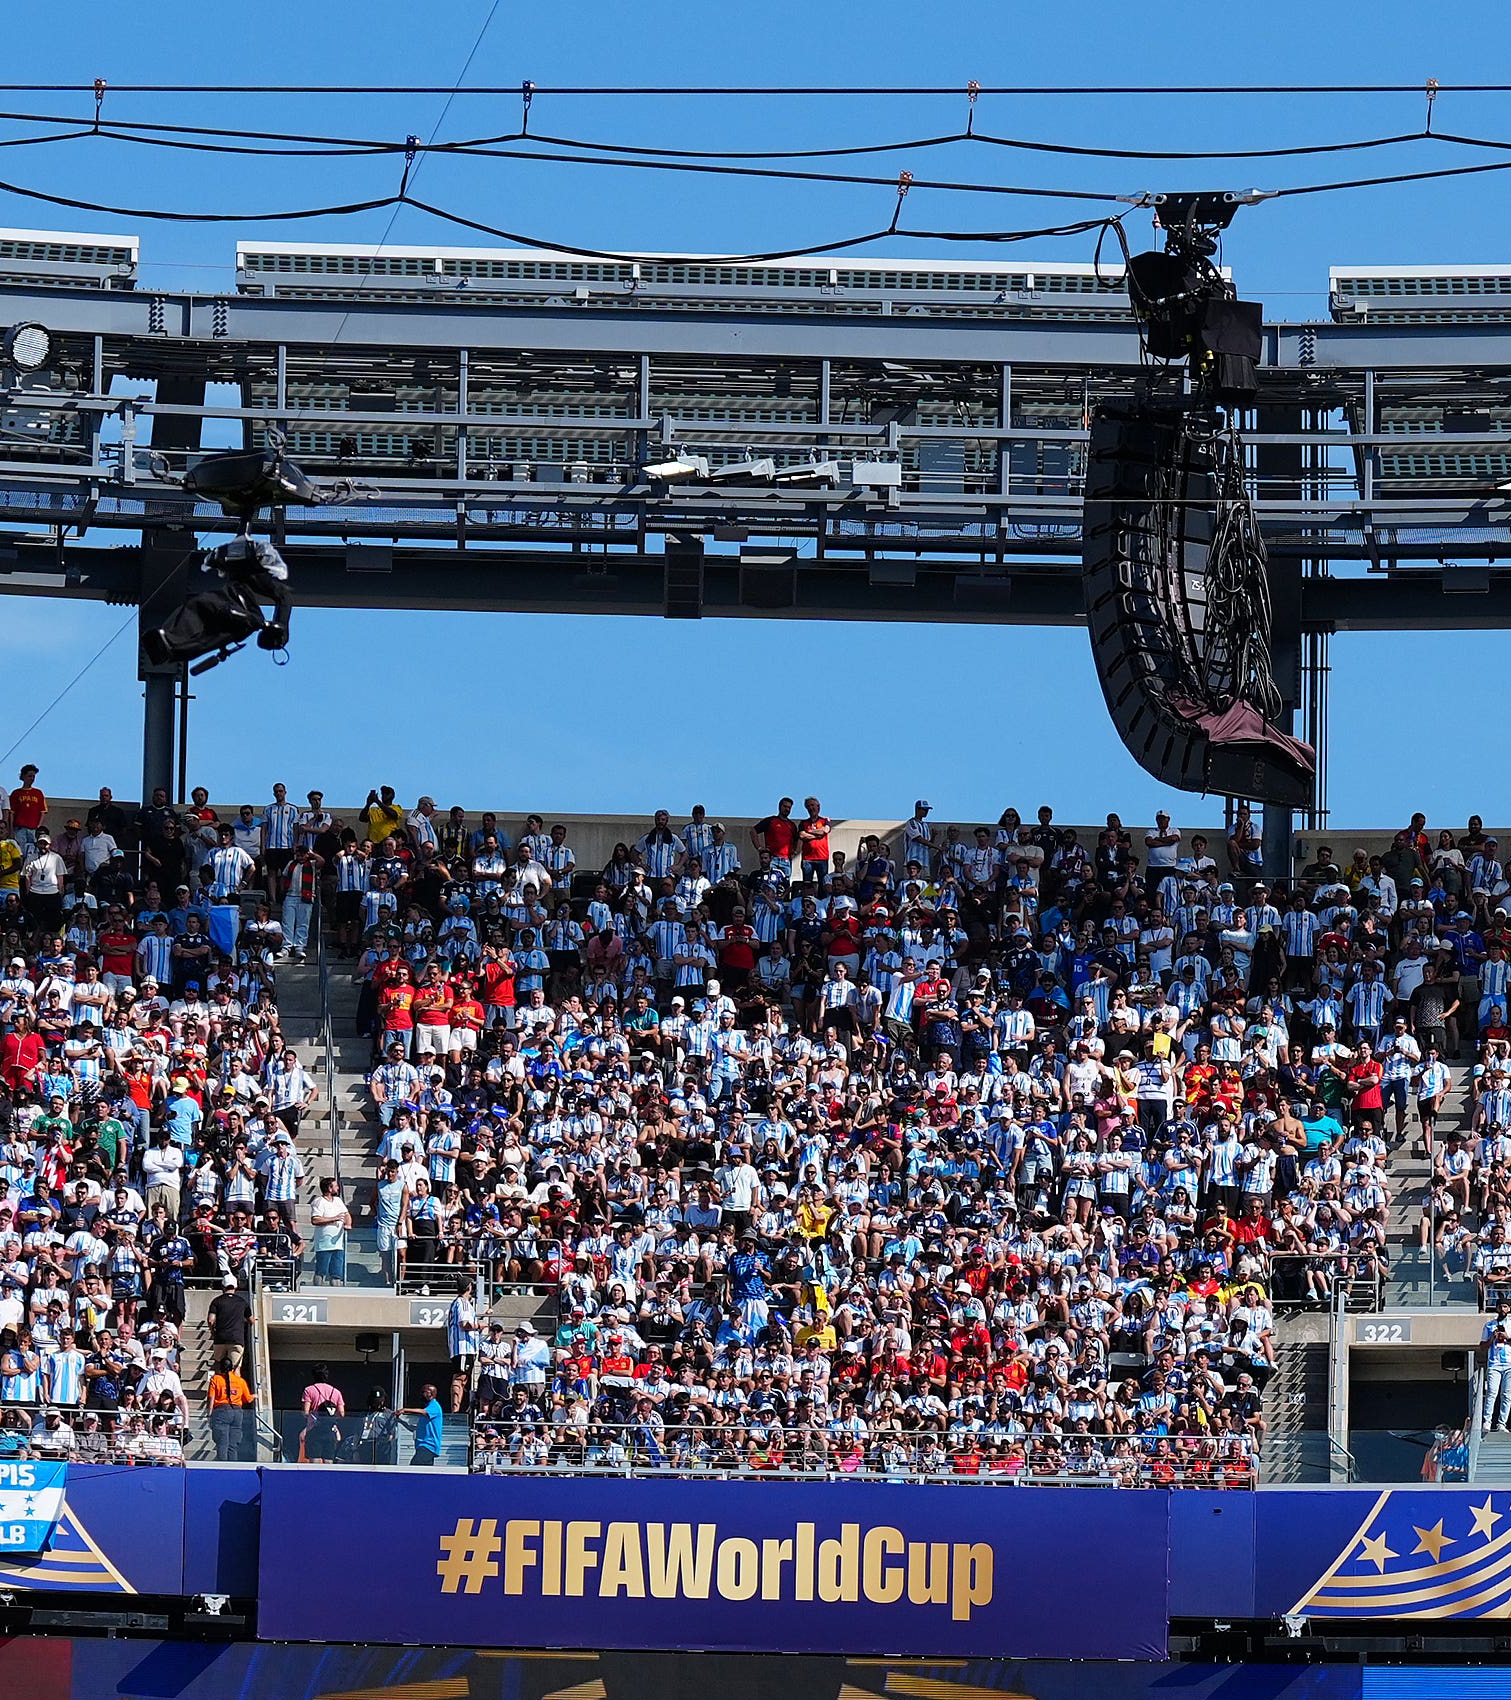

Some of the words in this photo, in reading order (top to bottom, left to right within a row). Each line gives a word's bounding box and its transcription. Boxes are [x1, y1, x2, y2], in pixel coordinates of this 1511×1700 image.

[282, 1304, 319, 1323] 321
[1364, 1324, 1403, 1342] 322
[436, 1518, 995, 1622] #FIFAWorldCup
